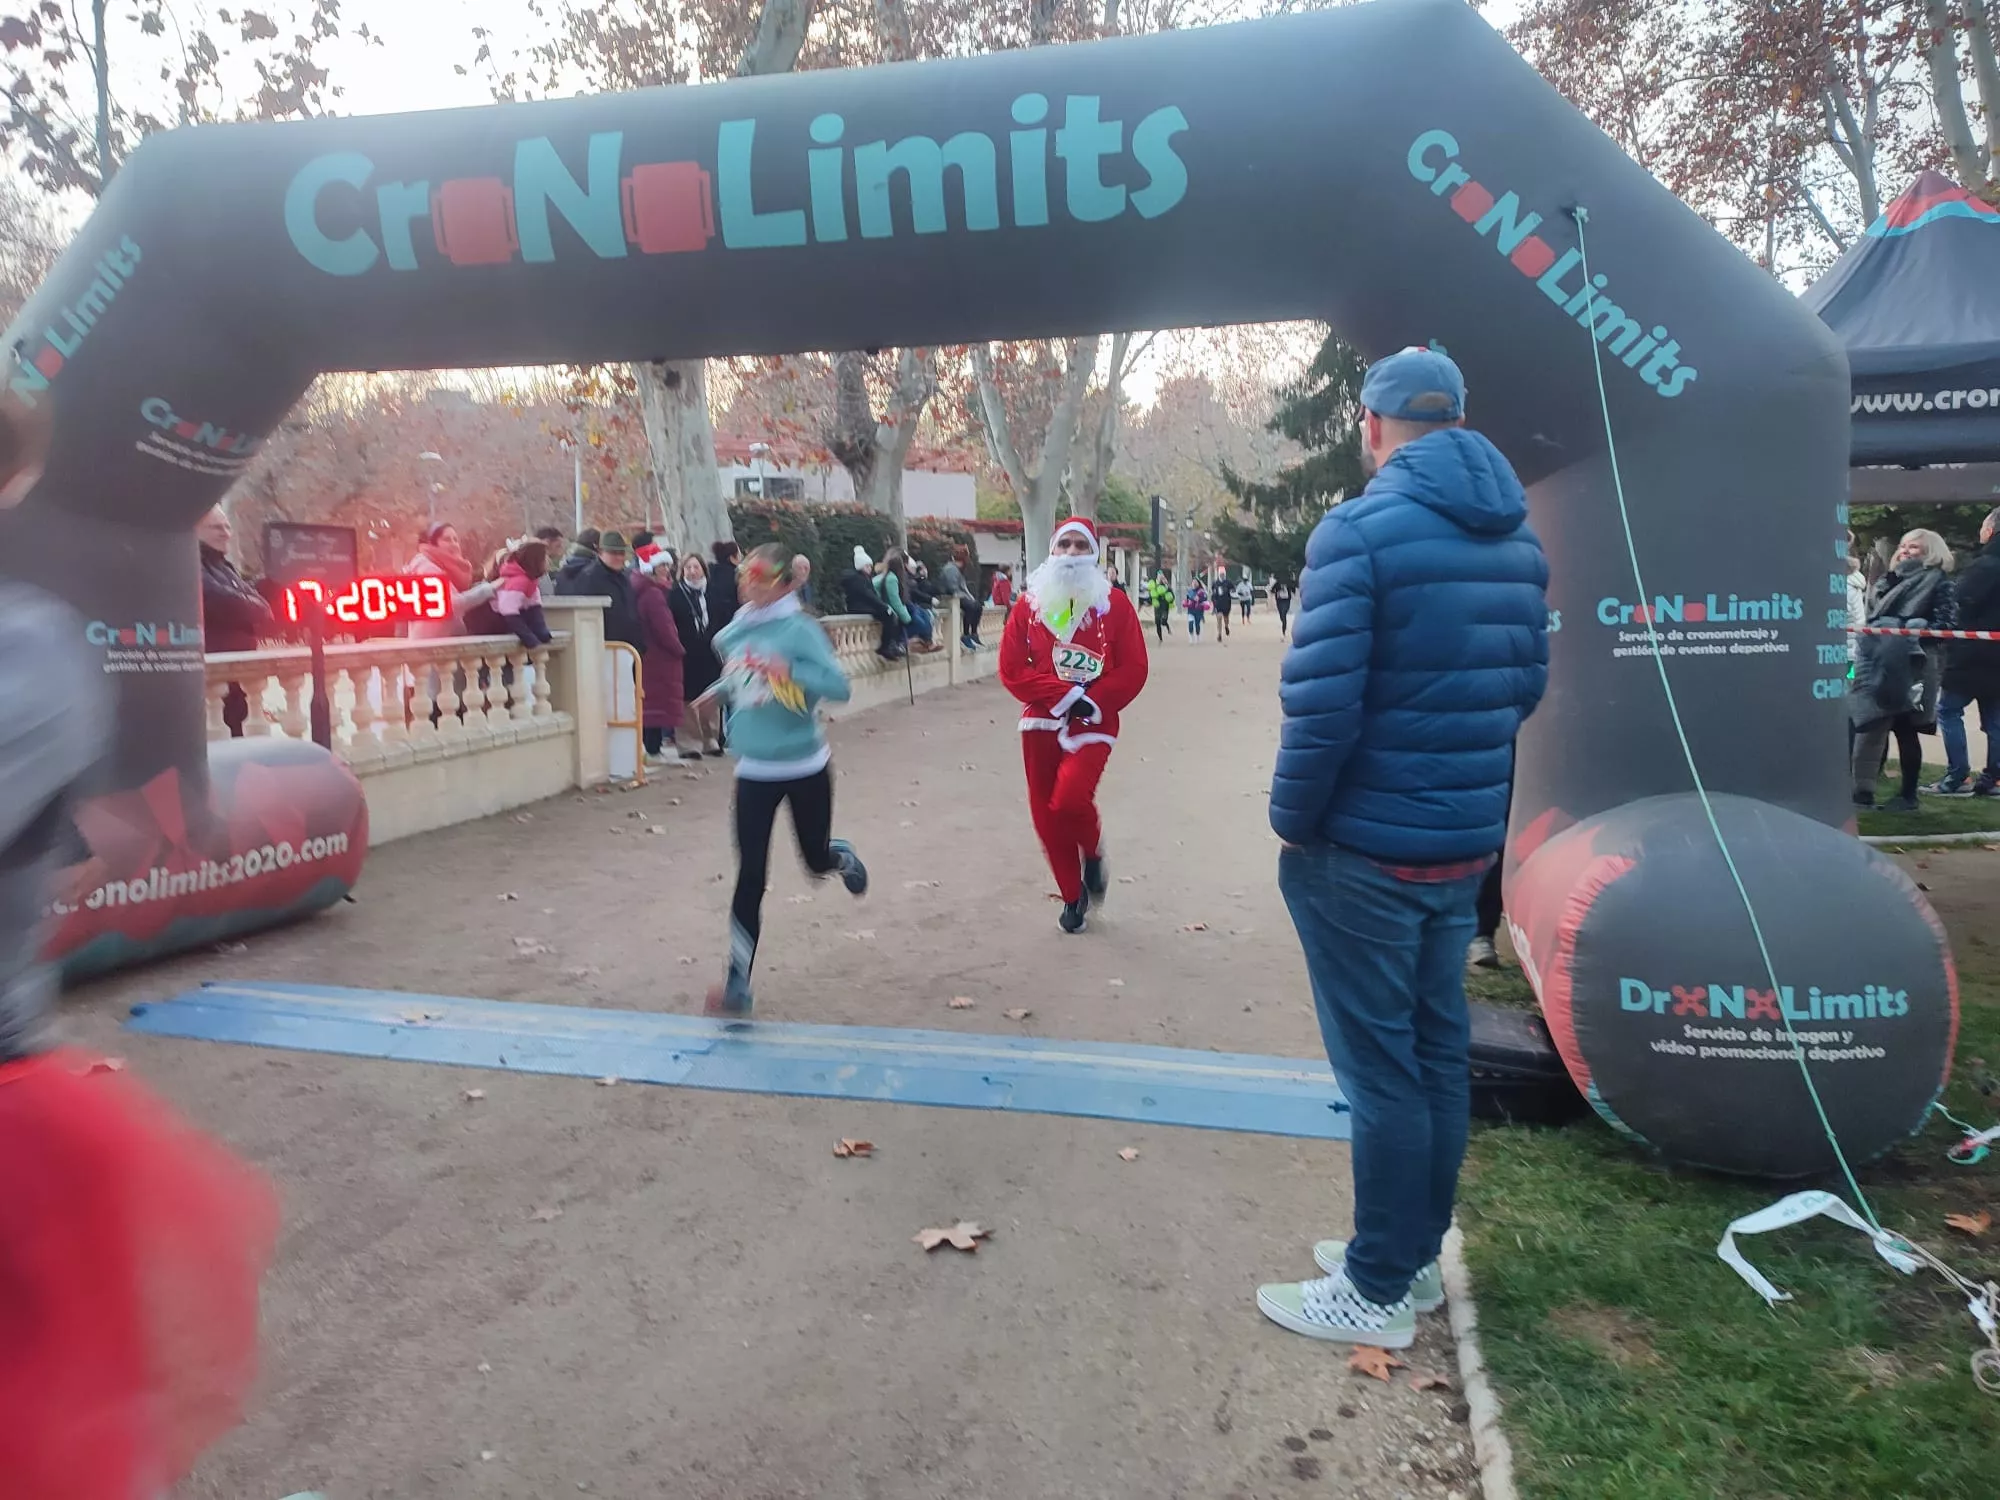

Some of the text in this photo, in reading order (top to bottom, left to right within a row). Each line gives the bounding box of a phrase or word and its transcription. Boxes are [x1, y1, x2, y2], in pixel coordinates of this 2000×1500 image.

[1667, 629, 1684, 640] de
[1686, 627, 1769, 640] cronometraje
[1770, 629, 1779, 640] y
[1659, 643, 1676, 655] de
[1678, 643, 1727, 655] eventos
[1729, 641, 1789, 654] deportivos
[1059, 649, 1098, 673] 229
[1683, 1023, 1854, 1045] Servicio de imagen y
[1699, 1045, 1805, 1060] promocional
[1807, 1044, 1886, 1063] deportivo
